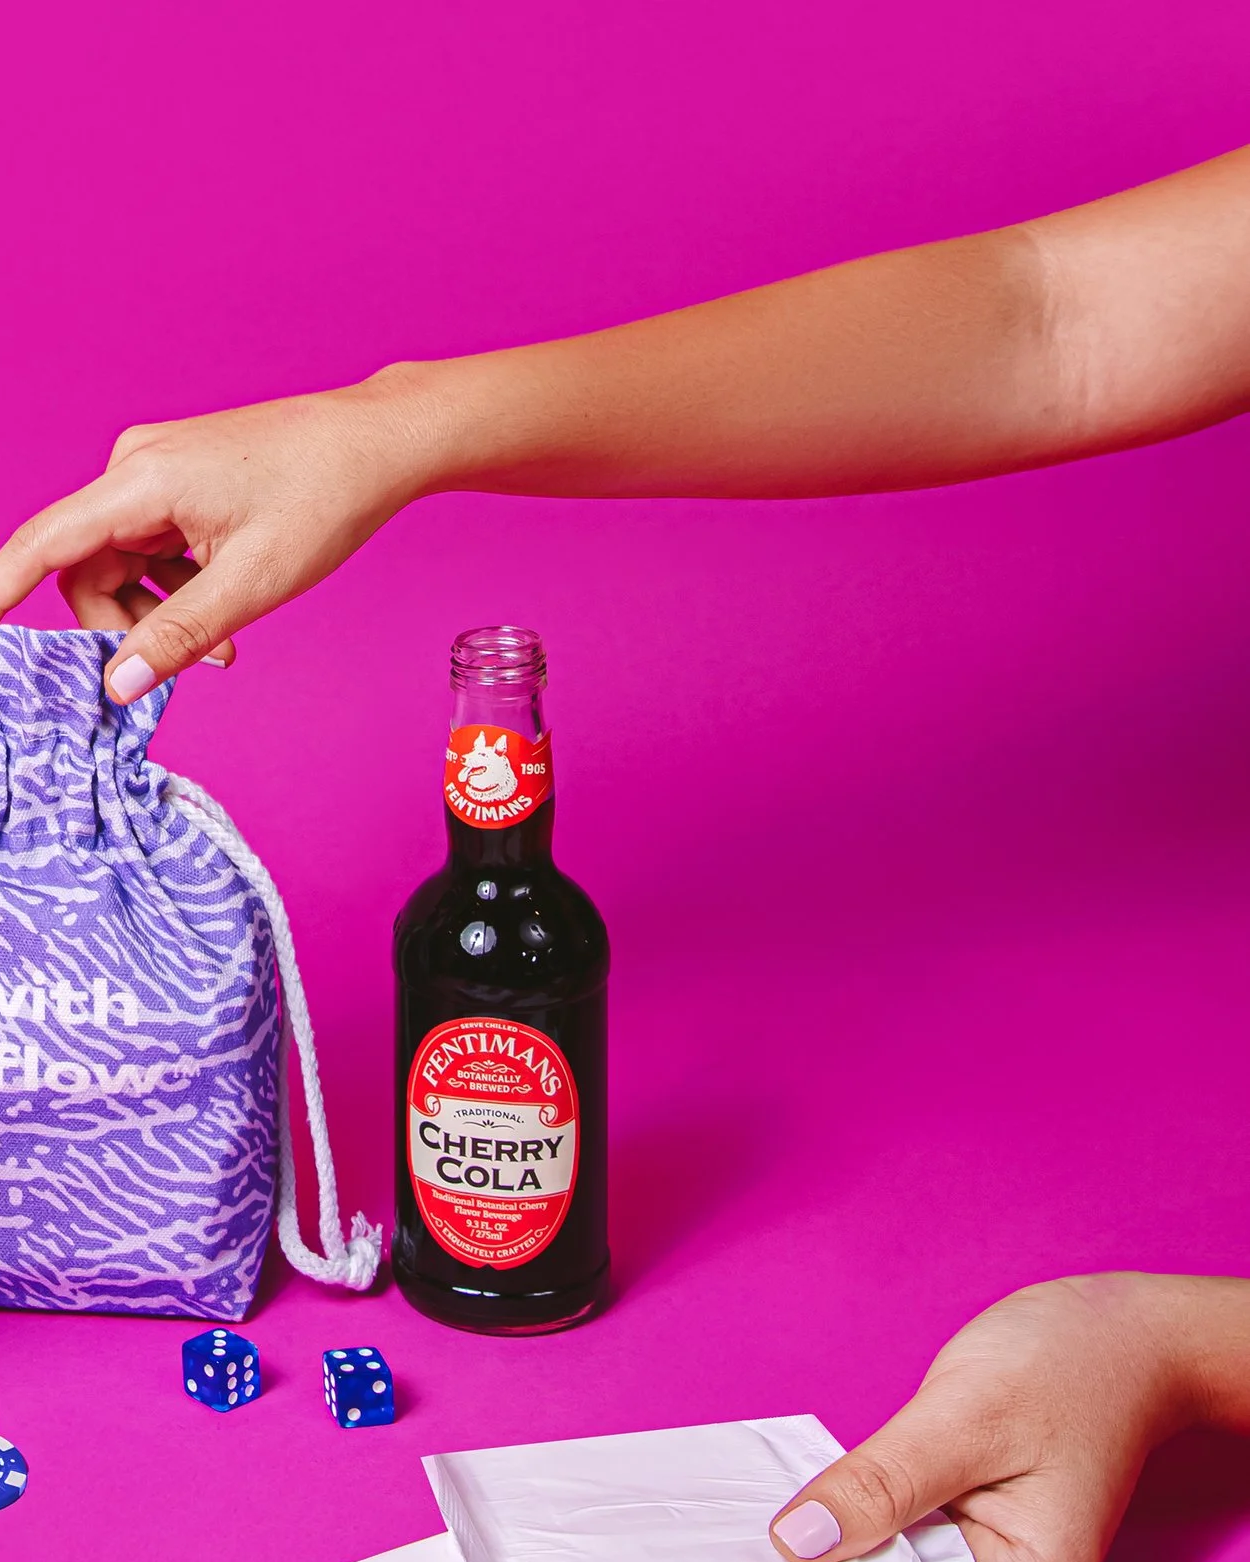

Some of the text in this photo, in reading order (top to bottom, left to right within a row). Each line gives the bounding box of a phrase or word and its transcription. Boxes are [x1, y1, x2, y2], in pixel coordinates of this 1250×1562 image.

[520, 763, 546, 775] 1905
[445, 782, 533, 822] FENTIMANS
[460, 1022, 519, 1033] SERVE CHILLED
[421, 1032, 562, 1097] FENTIMANS
[457, 1070, 522, 1084] BOTANICALLY
[469, 1082, 511, 1093] BREWED
[455, 1108, 522, 1123] TRADITIONAL
[419, 1121, 565, 1163] CHERRY
[436, 1156, 543, 1192] COLA
[431, 1188, 548, 1211] Traditional Botanical Cherry
[454, 1206, 522, 1222] Flavor Beverage
[466, 1219, 479, 1229] 9.3
[441, 1227, 536, 1258] EXQUISITELY CRAFTED
[475, 1230, 503, 1241] 275ml
